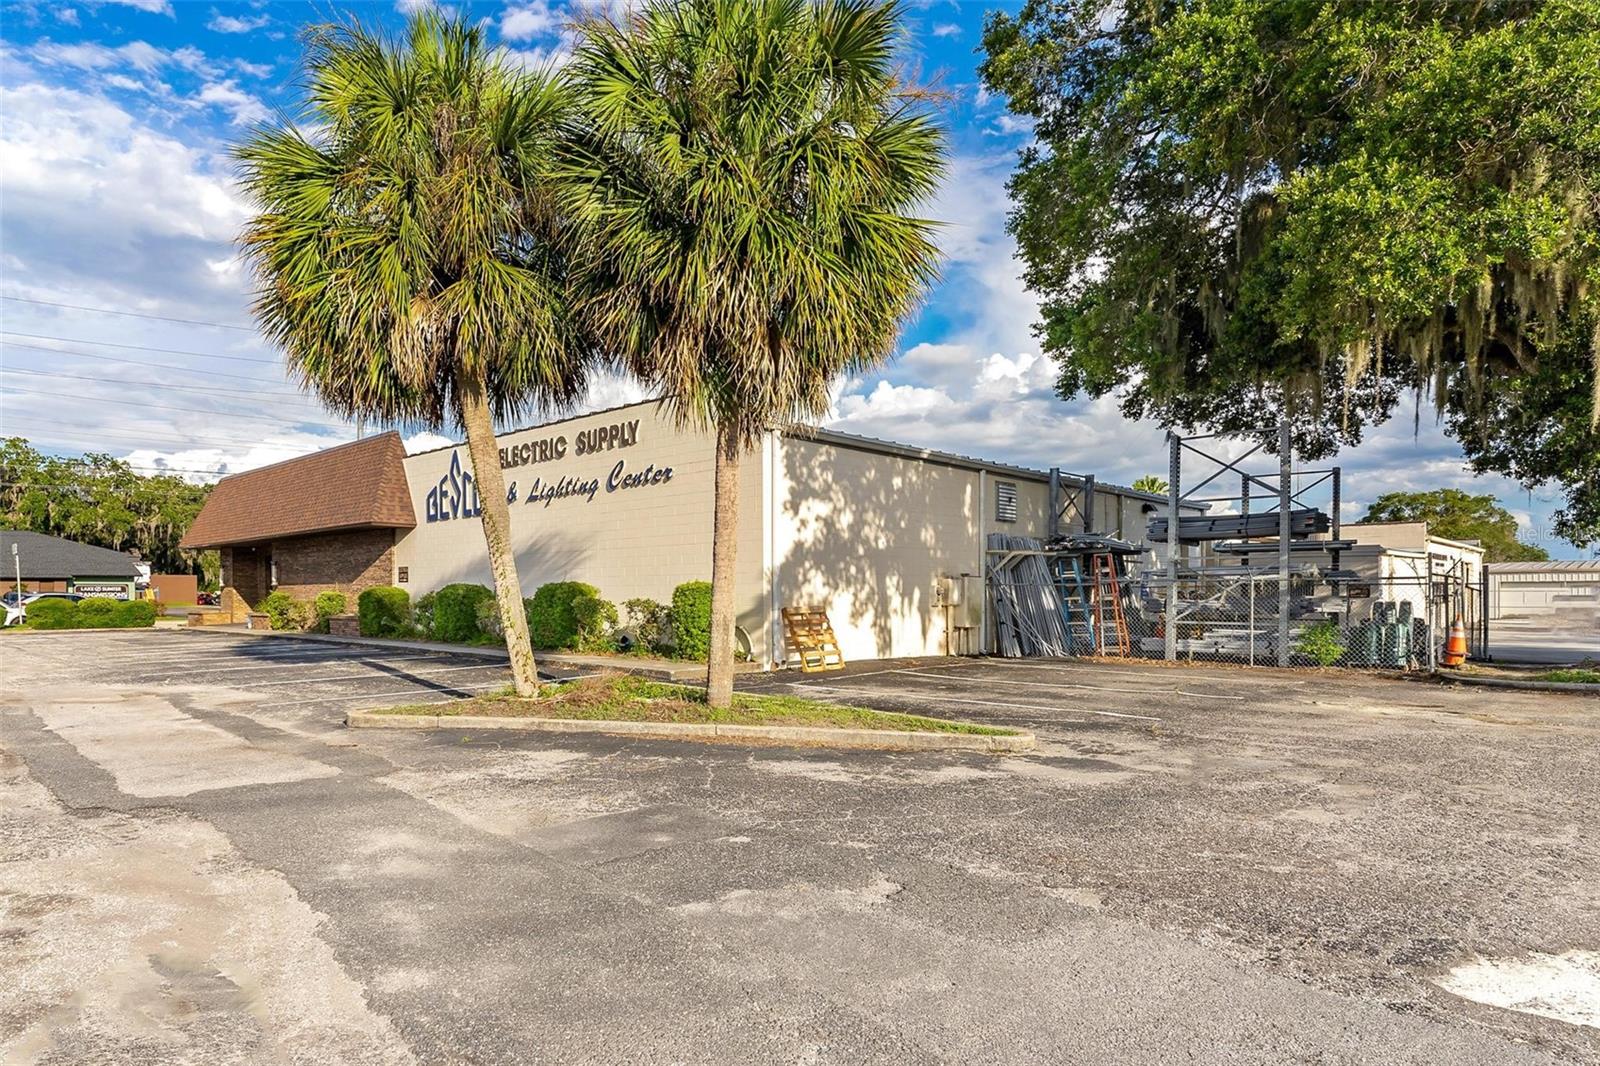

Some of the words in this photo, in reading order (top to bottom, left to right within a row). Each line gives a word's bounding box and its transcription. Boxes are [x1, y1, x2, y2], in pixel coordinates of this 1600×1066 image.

[499, 436, 567, 469] ELECTRIC
[575, 419, 640, 456] SUPPLY
[507, 480, 517, 505] &
[525, 477, 600, 508] Lighting
[606, 459, 674, 494] Center
